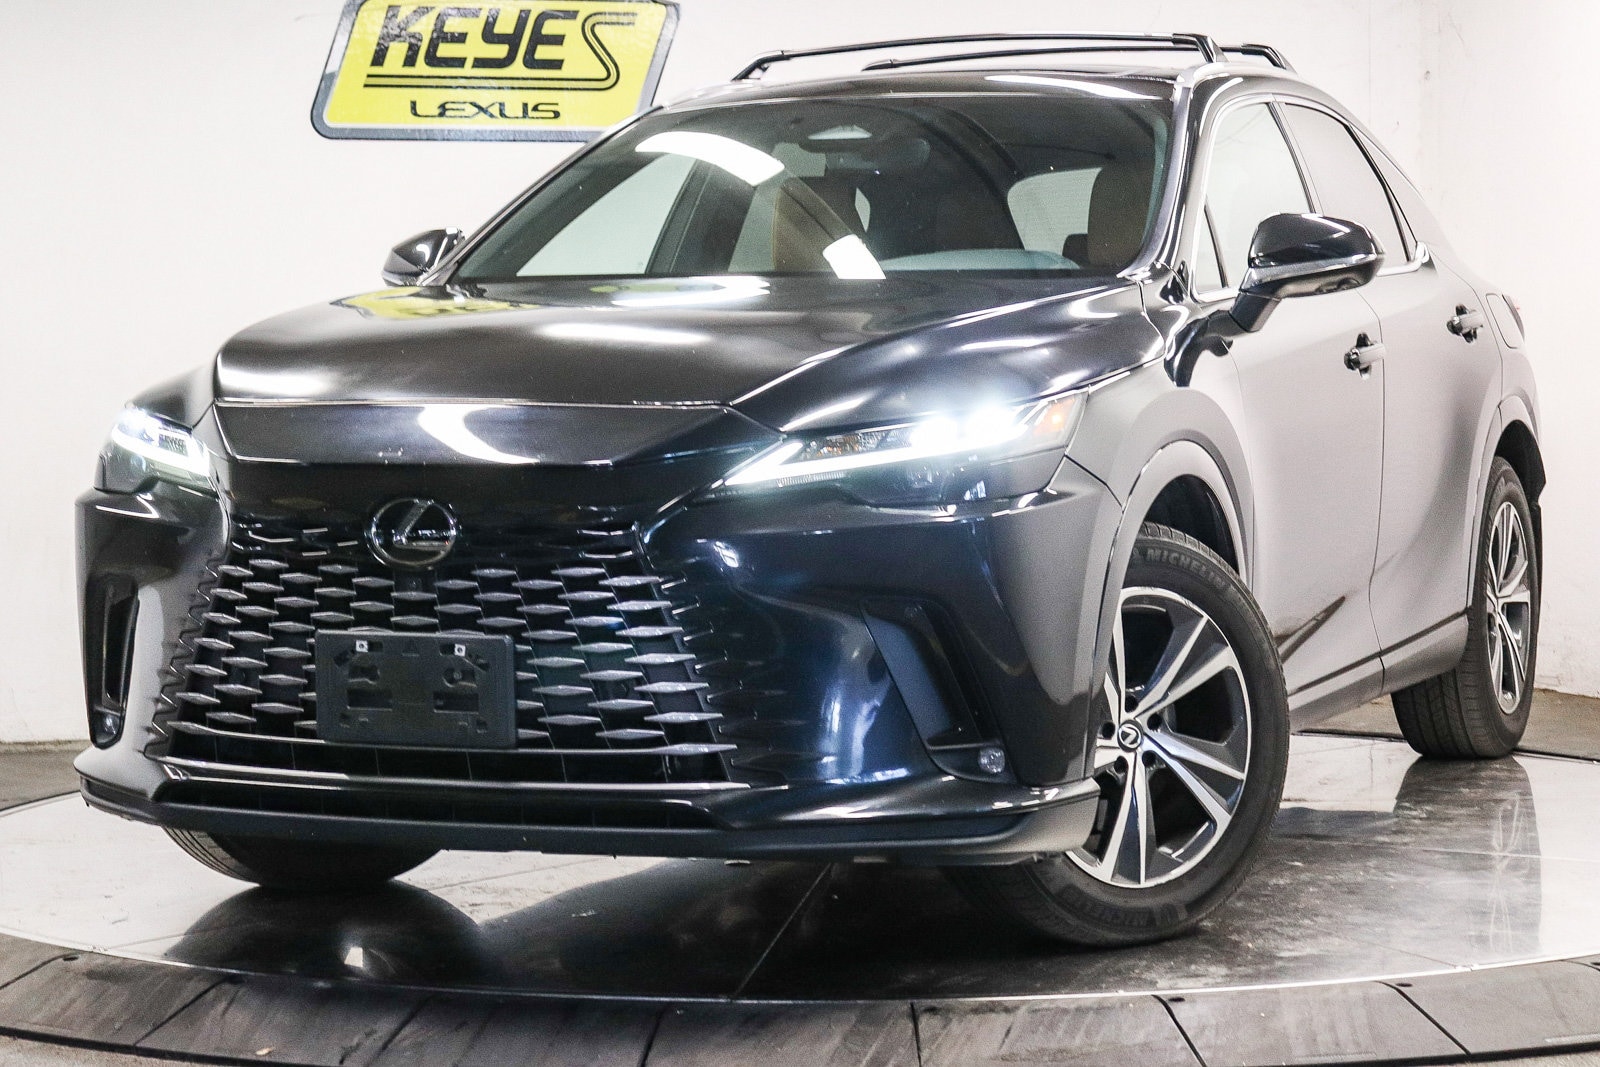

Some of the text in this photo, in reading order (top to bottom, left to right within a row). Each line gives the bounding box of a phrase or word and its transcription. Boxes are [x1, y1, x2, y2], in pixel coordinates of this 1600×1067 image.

[364, 4, 638, 91] KEYES
[410, 100, 561, 119] LEXUS
[1146, 547, 1226, 588] MICHELIN
